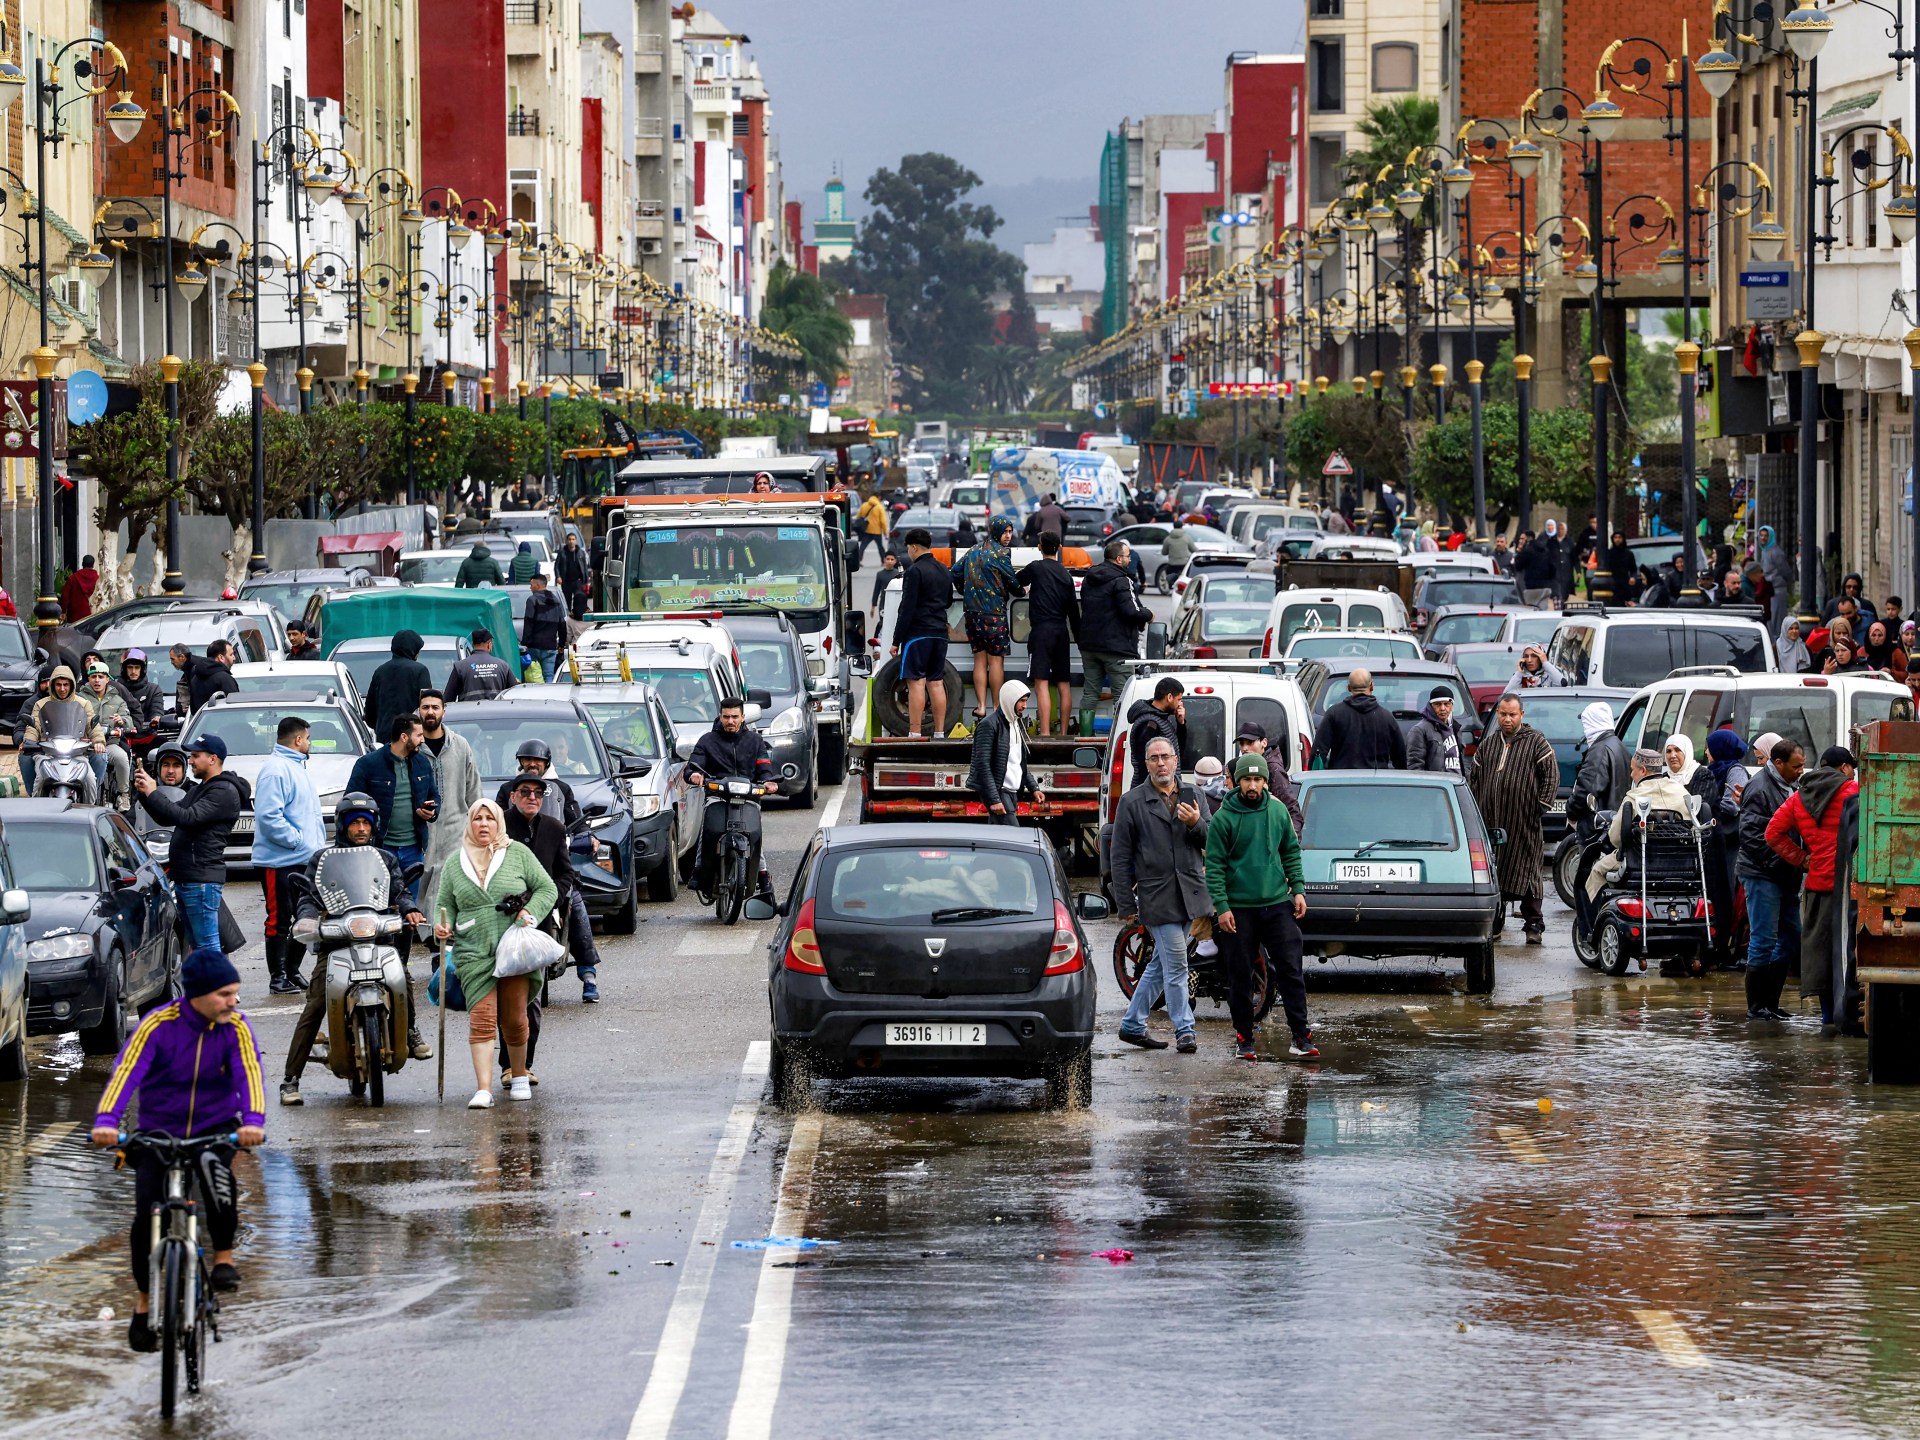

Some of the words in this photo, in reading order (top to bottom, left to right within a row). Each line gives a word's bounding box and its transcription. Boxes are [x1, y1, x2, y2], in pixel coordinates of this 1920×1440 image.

[1747, 275, 1770, 283] Allianz
[997, 482, 1019, 490] BIMBO
[1069, 481, 1093, 494] BIMBO
[657, 532, 676, 541] 1459
[789, 530, 808, 538] 1459
[716, 587, 742, 596] الله
[1343, 865, 1370, 877] 17651
[1409, 866, 1413, 877] 1
[894, 1026, 932, 1041] 36916
[972, 1026, 980, 1041] 2
[214, 1162, 232, 1206] NIKE
